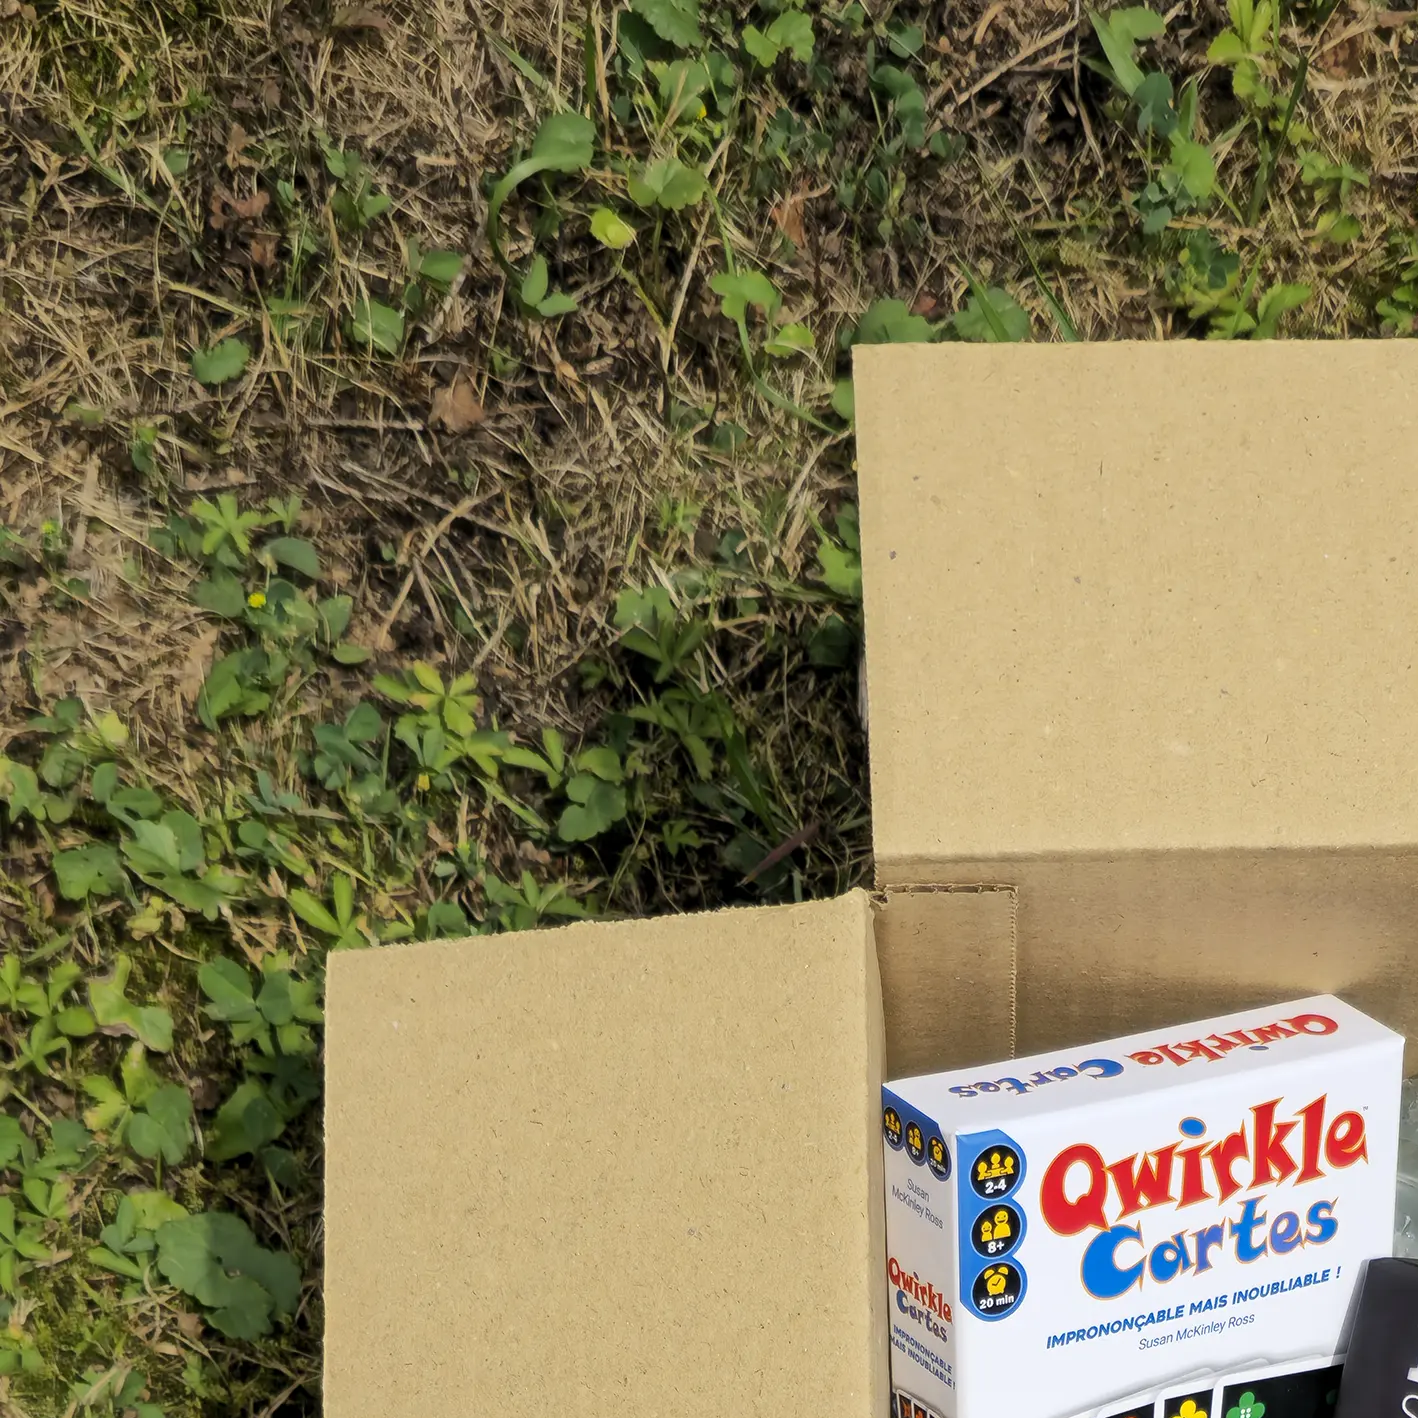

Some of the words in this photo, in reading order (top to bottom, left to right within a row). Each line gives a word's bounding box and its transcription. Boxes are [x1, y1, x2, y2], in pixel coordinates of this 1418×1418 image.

[1124, 1013, 1339, 1067] Qwirkle
[947, 1058, 1125, 1098] Cartes
[907, 1178, 930, 1202] Susan
[985, 1178, 1007, 1194] 2-4
[1040, 1093, 1369, 1238] Qwirkle
[892, 1185, 925, 1218] McKinley
[925, 1207, 944, 1229] Ross
[987, 1241, 1005, 1254] 8+
[1080, 1195, 1341, 1301] Cartes
[888, 1257, 954, 1325] Qwirkle
[896, 1289, 948, 1344] Cartes
[979, 1297, 994, 1310] 20
[996, 1294, 1015, 1306] min
[1046, 1304, 1185, 1349] IMPRONONÇABLE
[1189, 1294, 1228, 1316] MAIS
[1232, 1268, 1332, 1306] INOUBLIABLE
[893, 1323, 953, 1375] IMPRONONÇABLE
[1138, 1332, 1173, 1351] Susan
[1176, 1321, 1226, 1343] McKinley
[1228, 1313, 1255, 1330] Ross
[890, 1335, 906, 1354] MAIS
[907, 1348, 952, 1389] INOUBLIABLE
